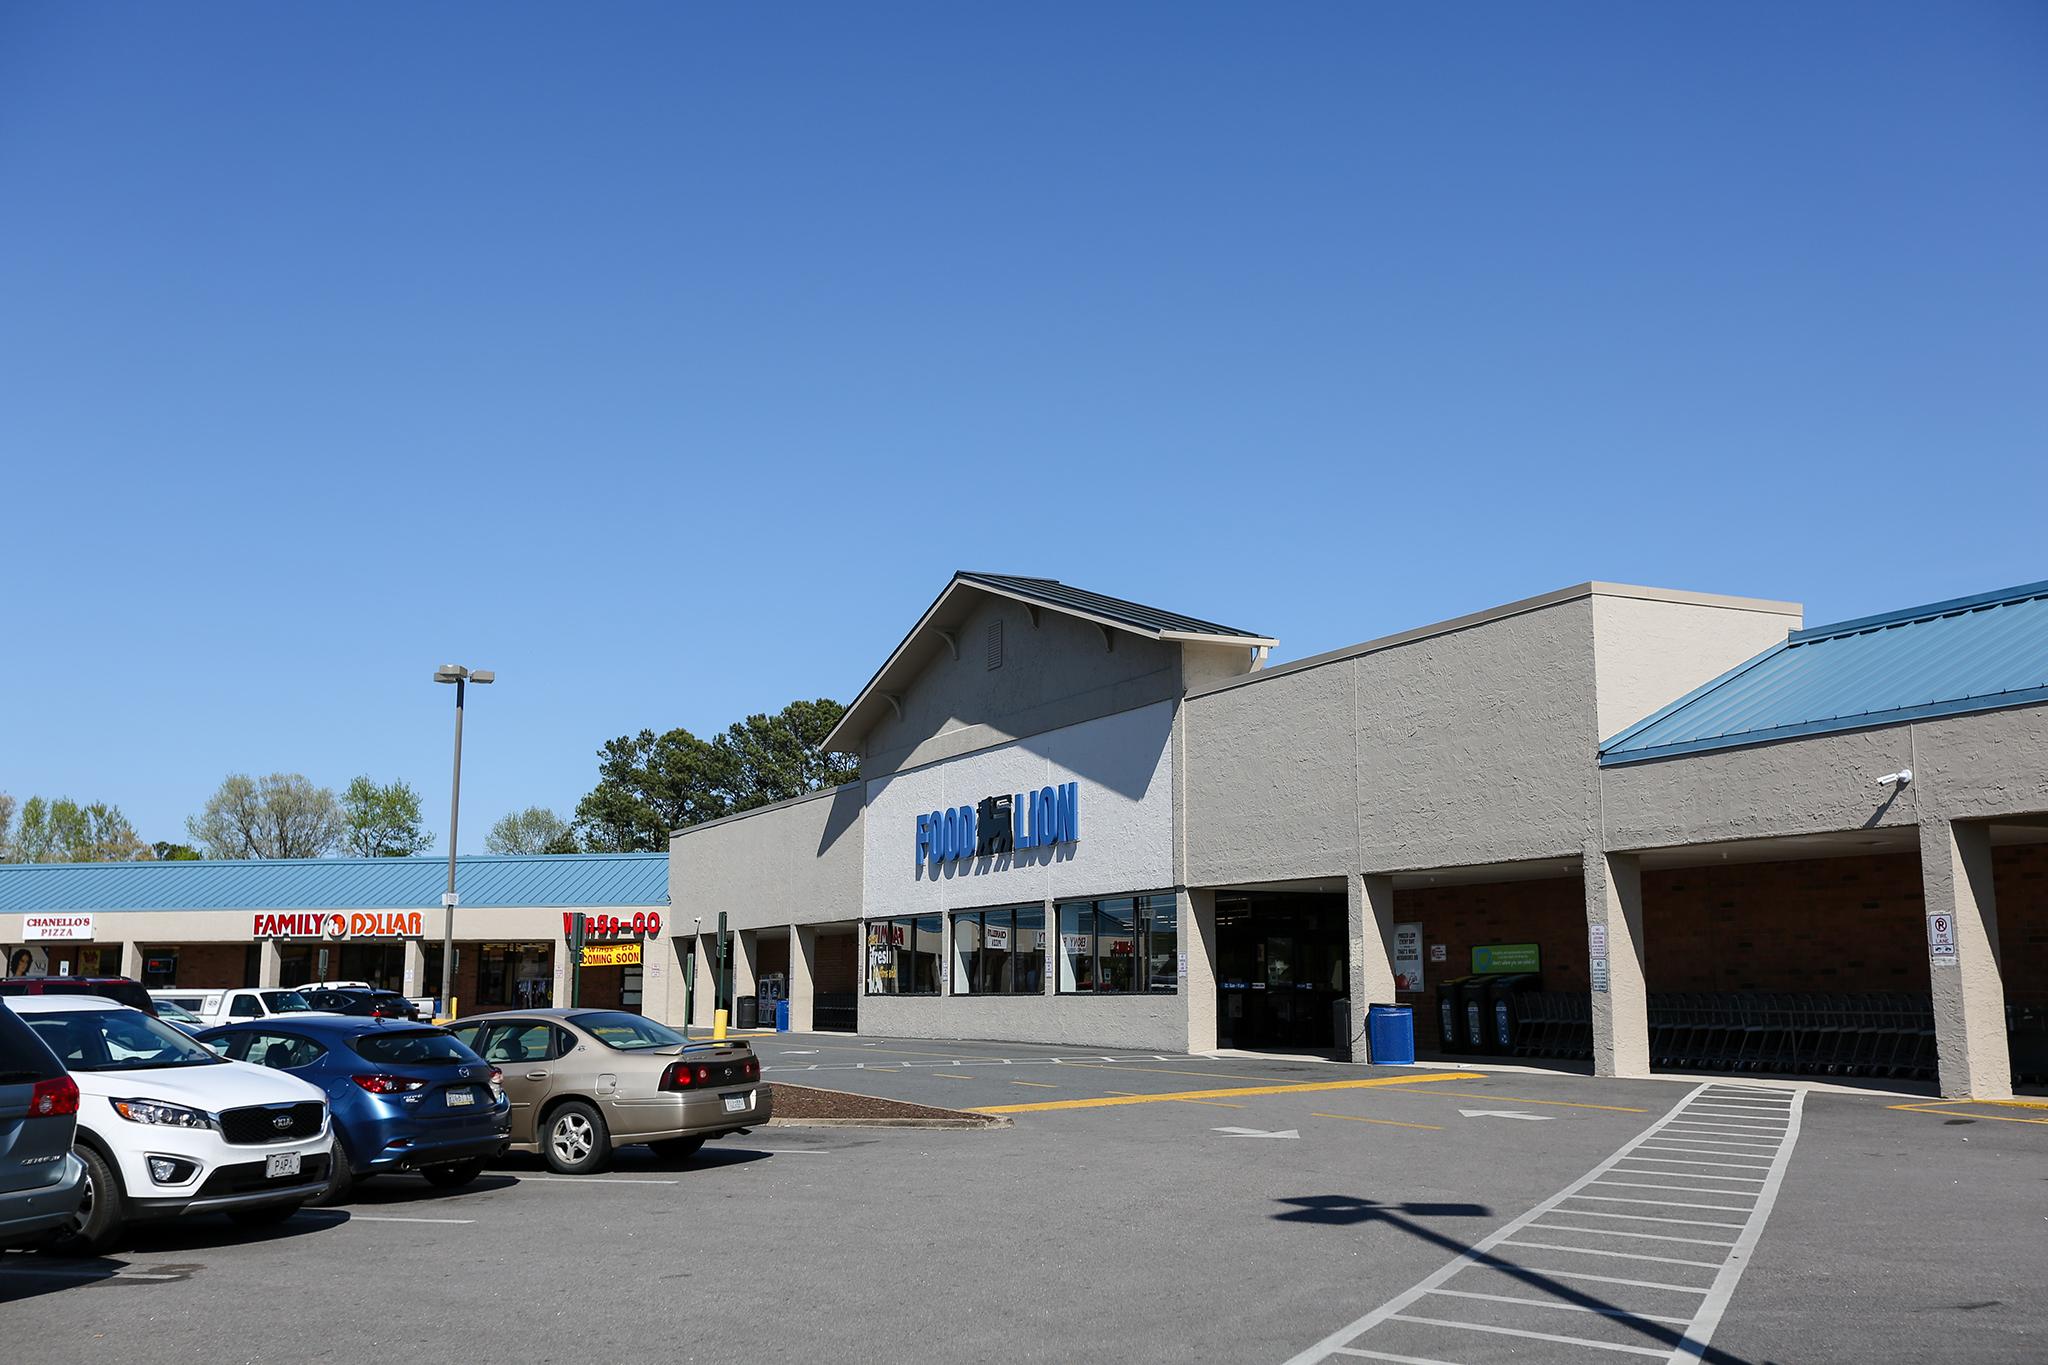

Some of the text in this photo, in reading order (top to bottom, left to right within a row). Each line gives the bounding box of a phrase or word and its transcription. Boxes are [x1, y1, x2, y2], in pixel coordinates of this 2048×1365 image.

[916, 782, 1078, 865] FOOD LION
[27, 917, 90, 927] CHANELLO'S
[253, 912, 421, 935] FAMILY DOLLAR
[563, 912, 660, 934] Wngs-GO
[41, 928, 73, 936] PIZZA
[583, 952, 639, 965] COMING SOON
